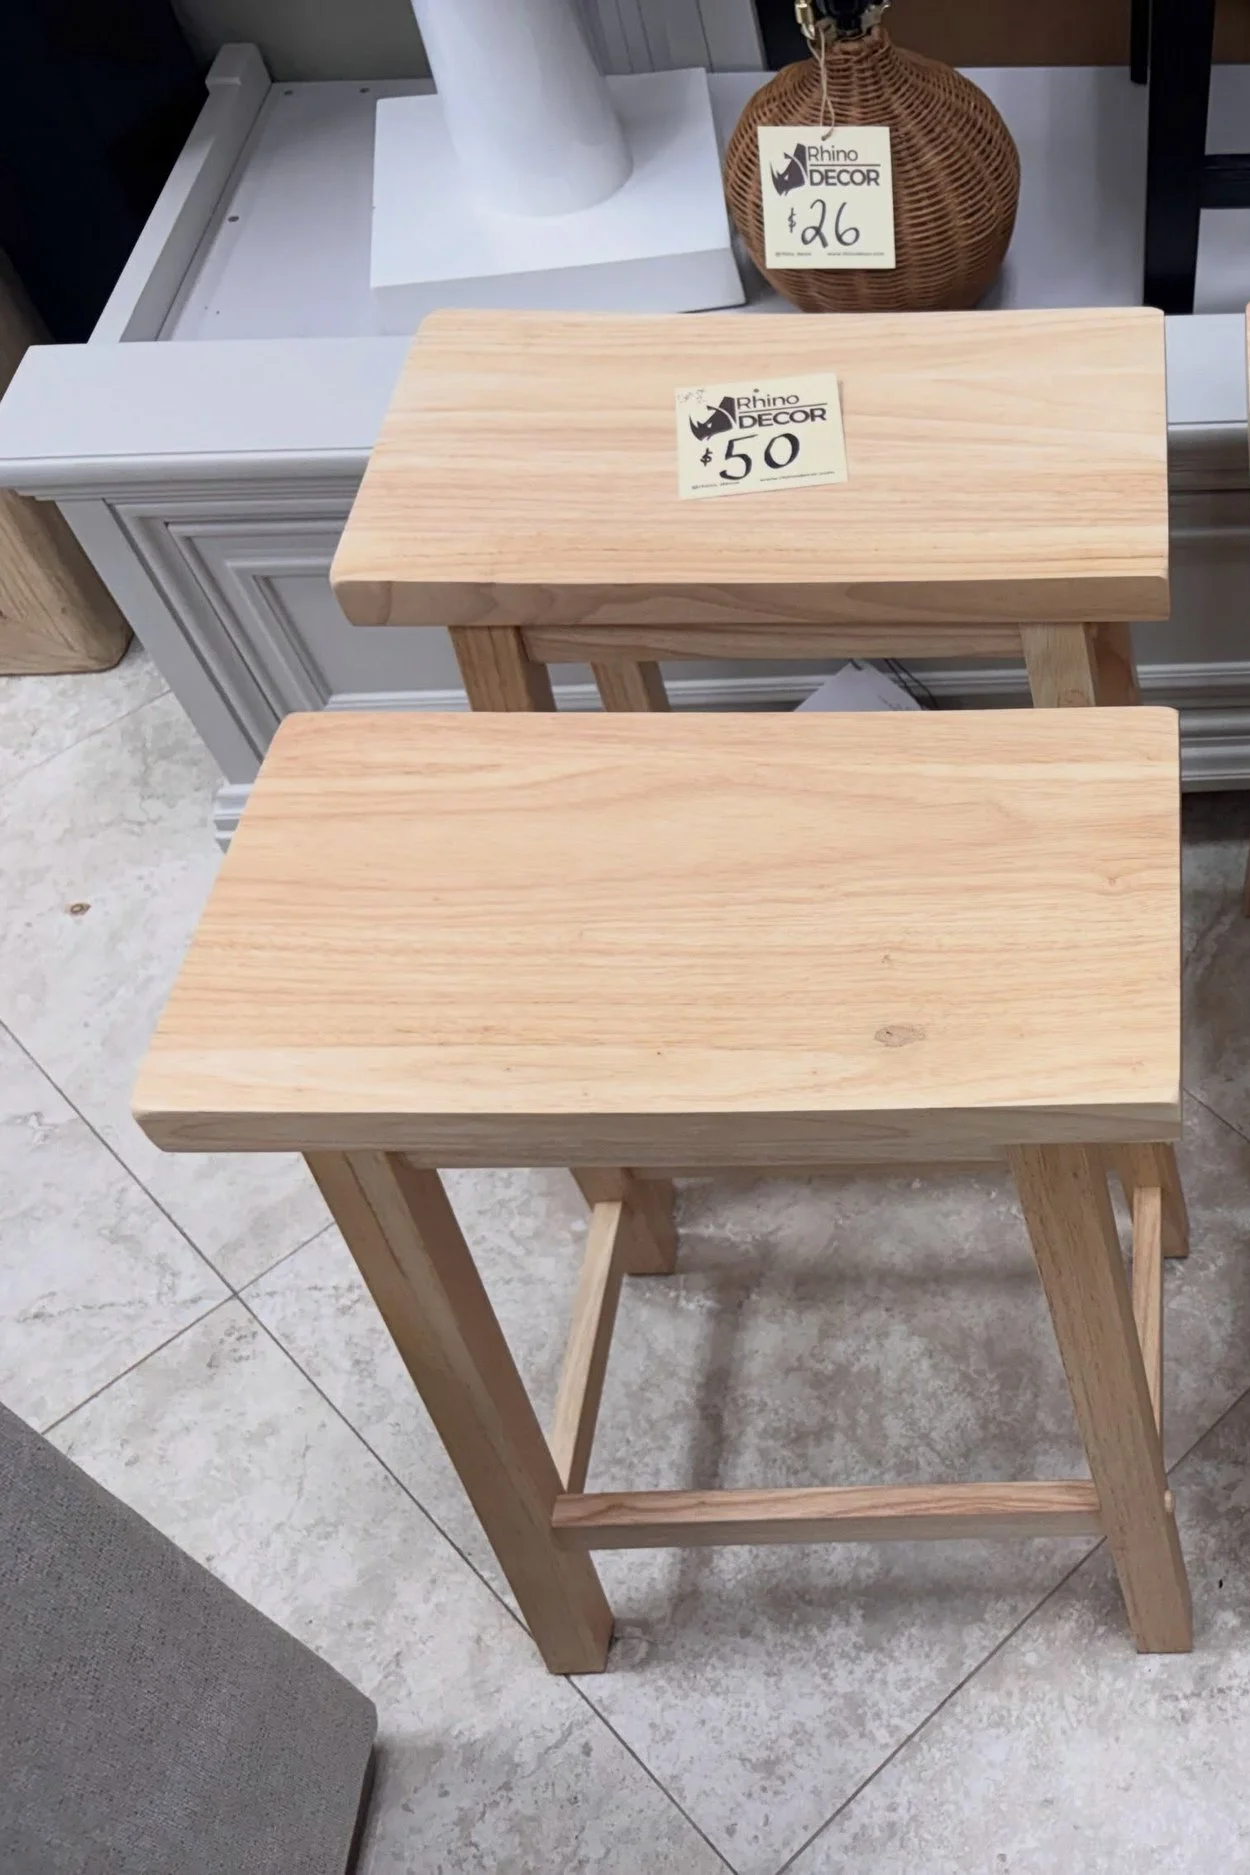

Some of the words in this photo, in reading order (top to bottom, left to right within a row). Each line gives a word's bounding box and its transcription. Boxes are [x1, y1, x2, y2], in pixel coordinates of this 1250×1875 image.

[807, 145, 858, 162] Rhino
[809, 169, 880, 187] DECOR
[787, 199, 860, 248] $26
[736, 394, 800, 409] Rhino
[738, 407, 827, 429] DECOR
[700, 433, 800, 480] $50
